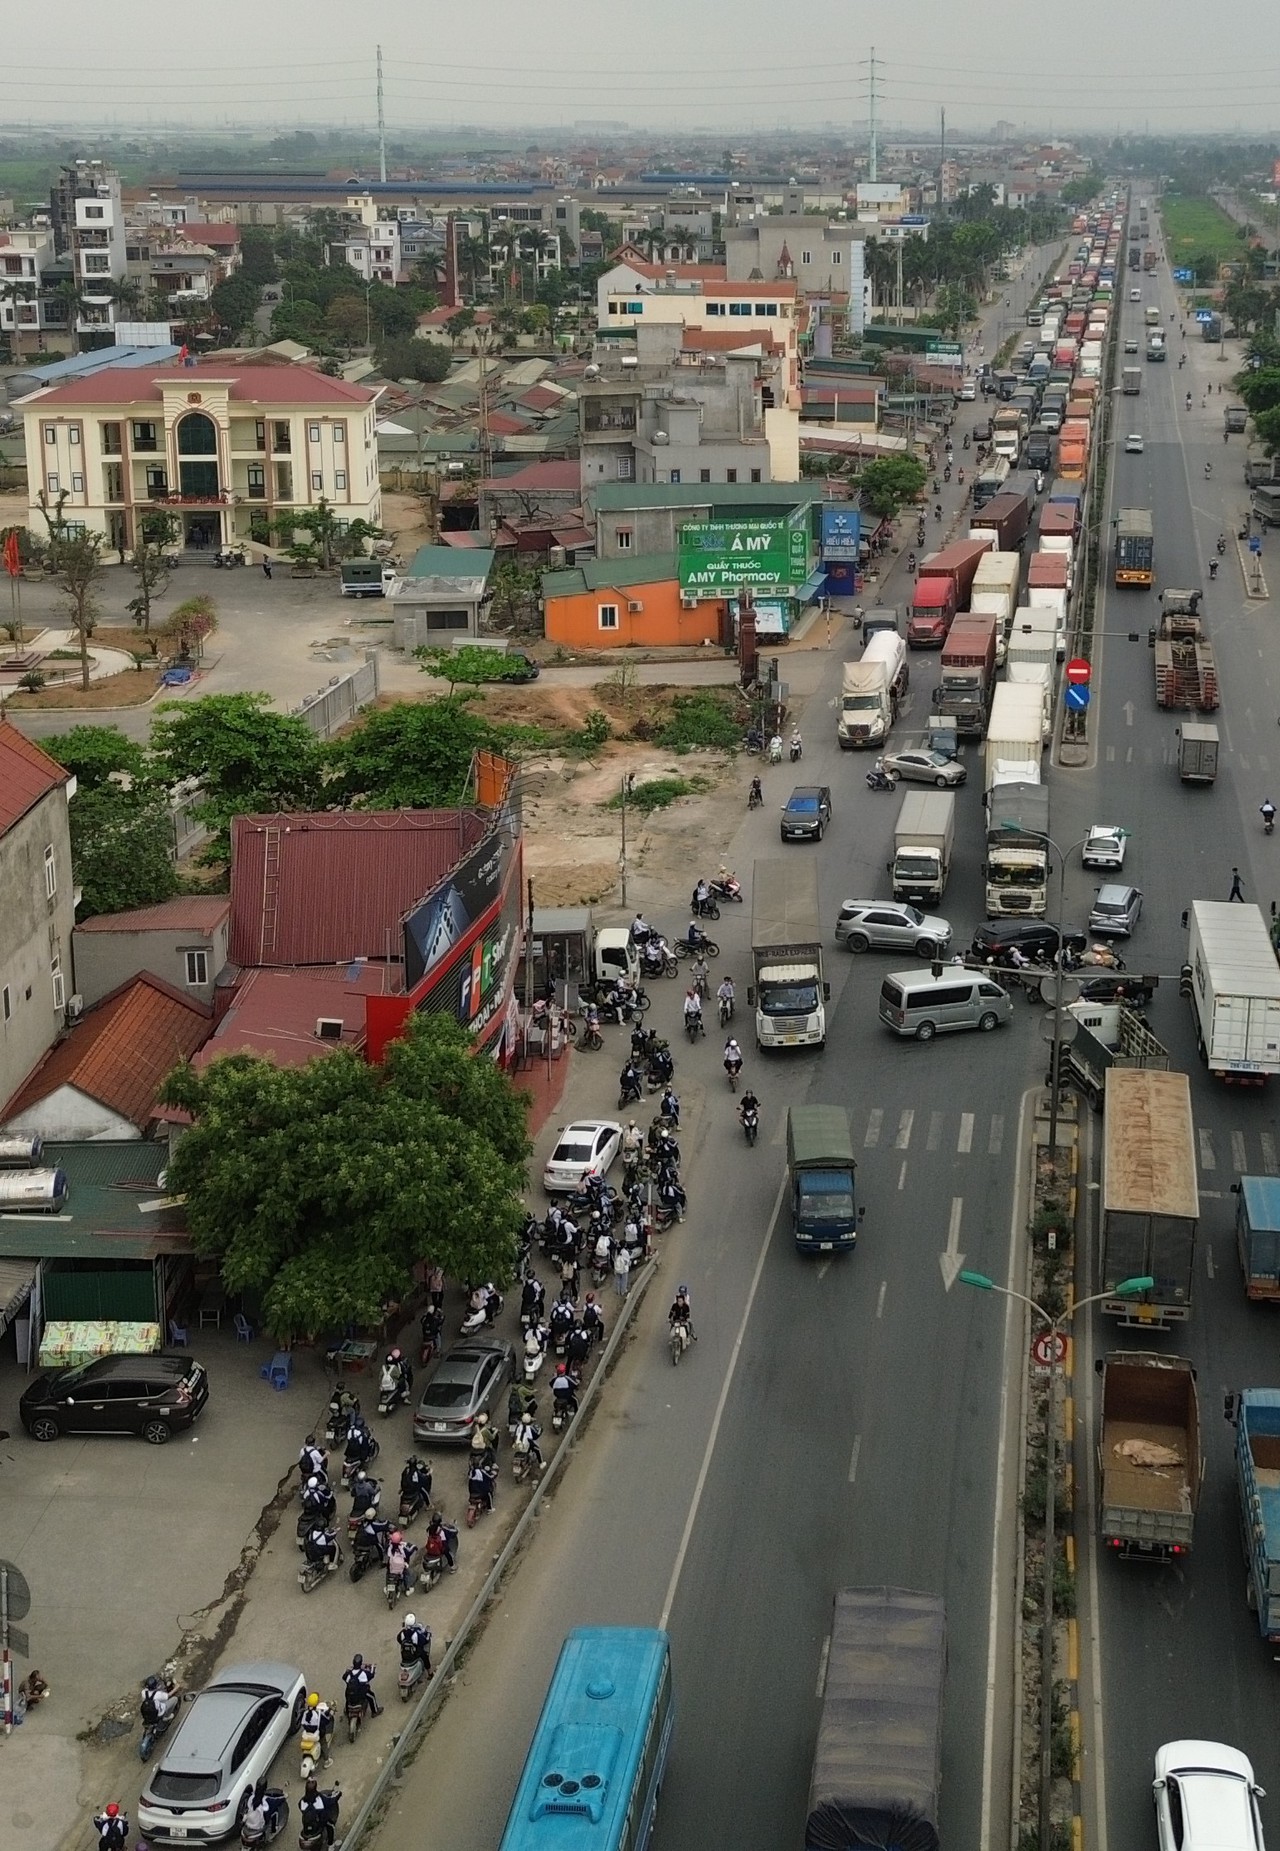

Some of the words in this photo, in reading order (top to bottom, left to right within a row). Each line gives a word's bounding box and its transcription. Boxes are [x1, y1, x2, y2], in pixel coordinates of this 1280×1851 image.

[730, 533, 743, 551] Á
[746, 534, 771, 551] MỸ
[688, 572, 716, 583] AMY
[721, 571, 781, 583] Pharmacy
